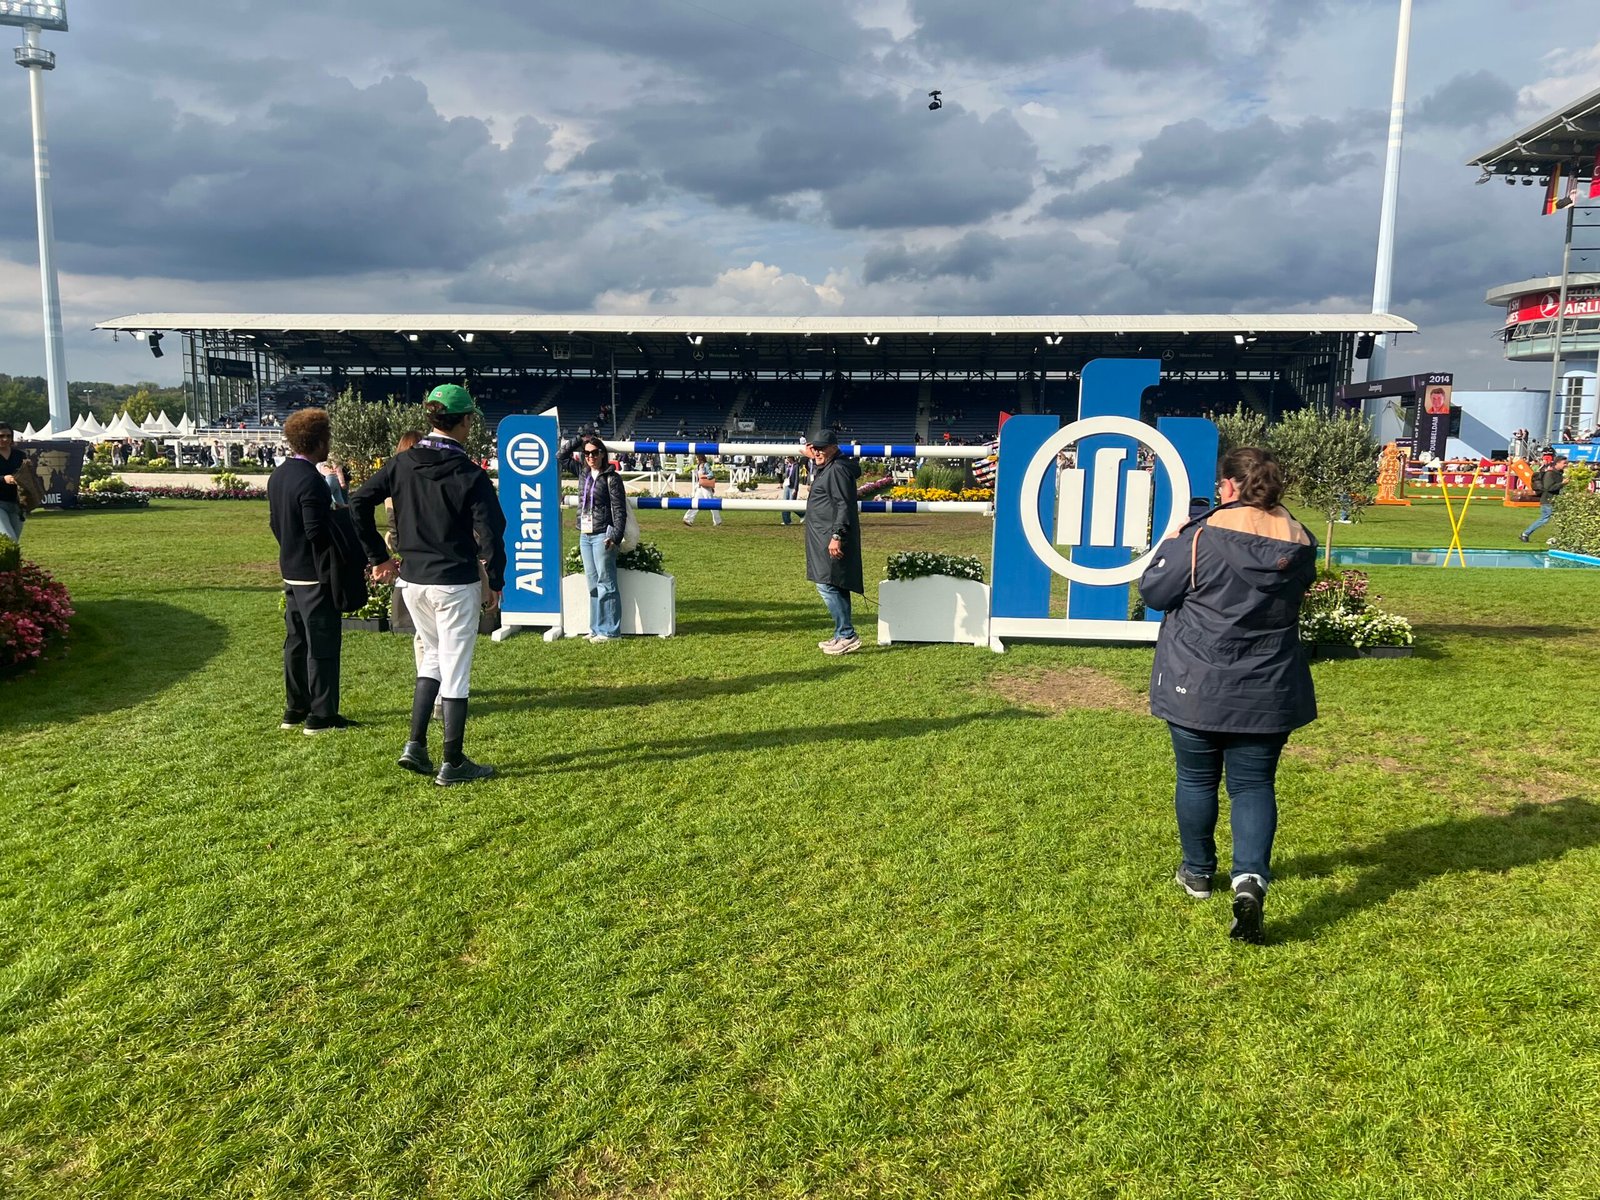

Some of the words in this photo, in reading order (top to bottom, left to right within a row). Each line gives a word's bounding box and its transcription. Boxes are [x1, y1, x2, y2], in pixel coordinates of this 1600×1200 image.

[1429, 375, 1450, 383] 2014
[1430, 416, 1438, 451] DUBBELDAM
[515, 483, 543, 595] Allianz
